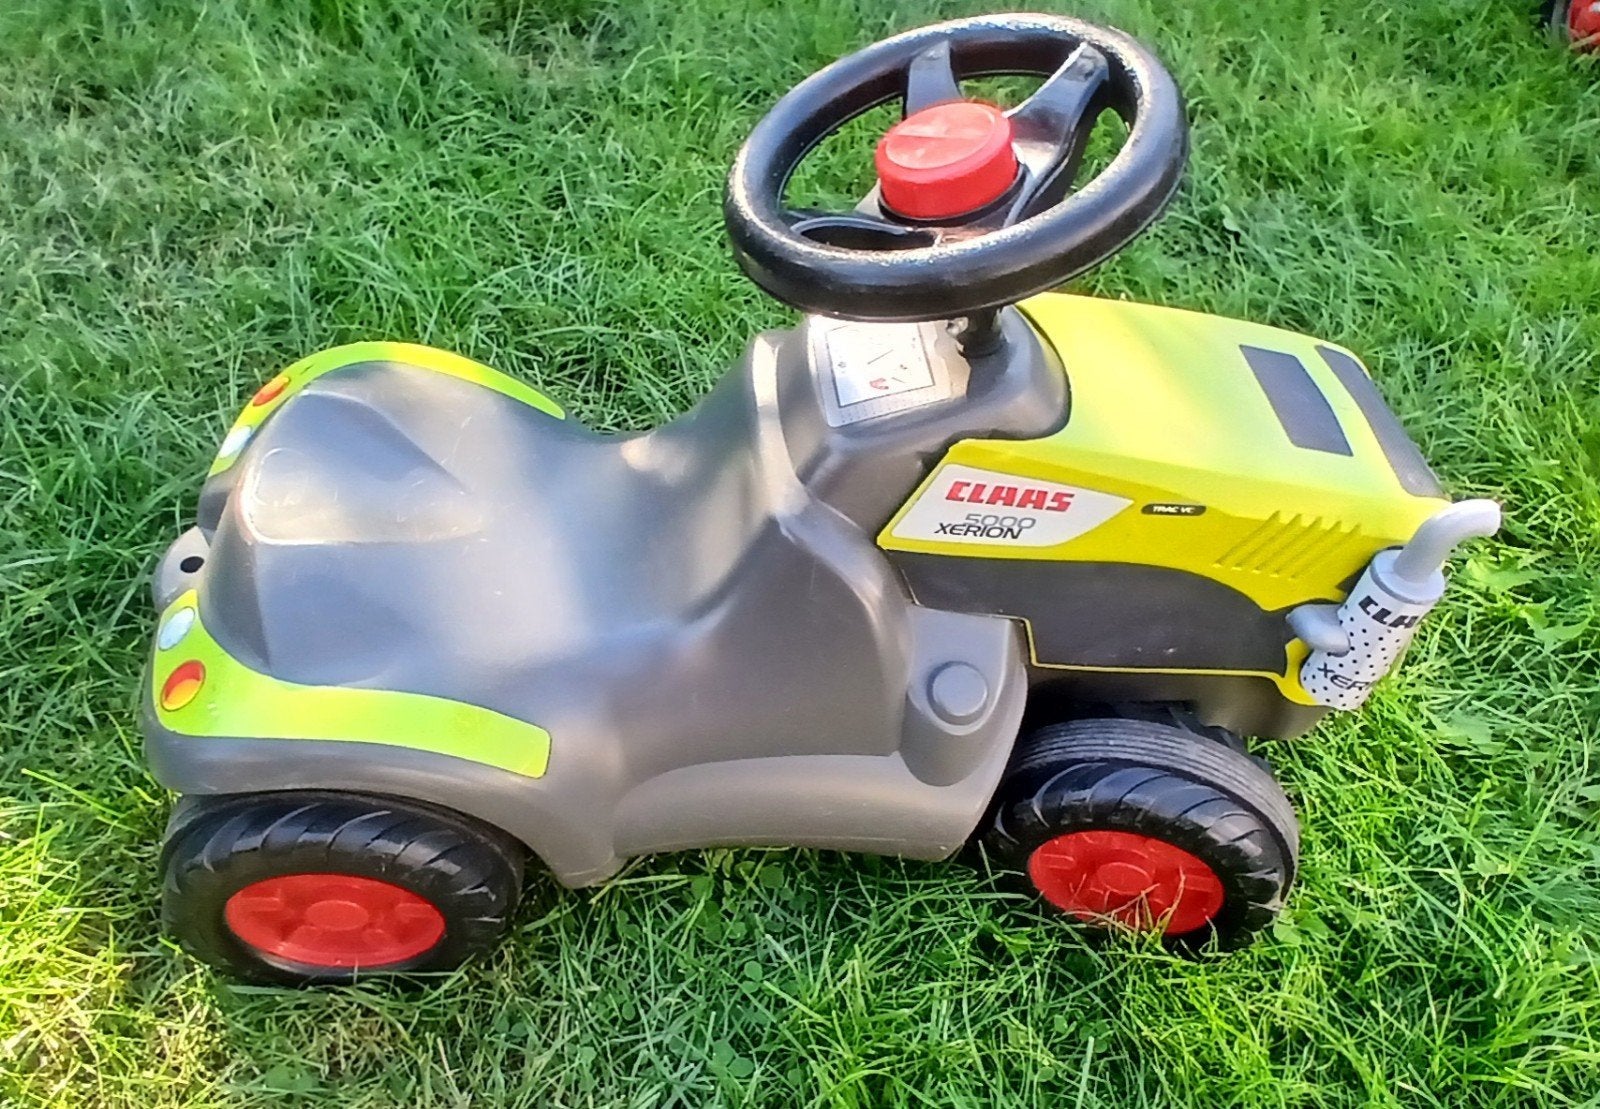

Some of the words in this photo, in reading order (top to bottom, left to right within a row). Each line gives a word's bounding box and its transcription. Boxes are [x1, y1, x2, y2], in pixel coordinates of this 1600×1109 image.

[945, 480, 1075, 512] CLAAS
[1153, 505, 1179, 513] TRAC
[964, 513, 1037, 529] 5000
[934, 522, 1023, 540] XERION
